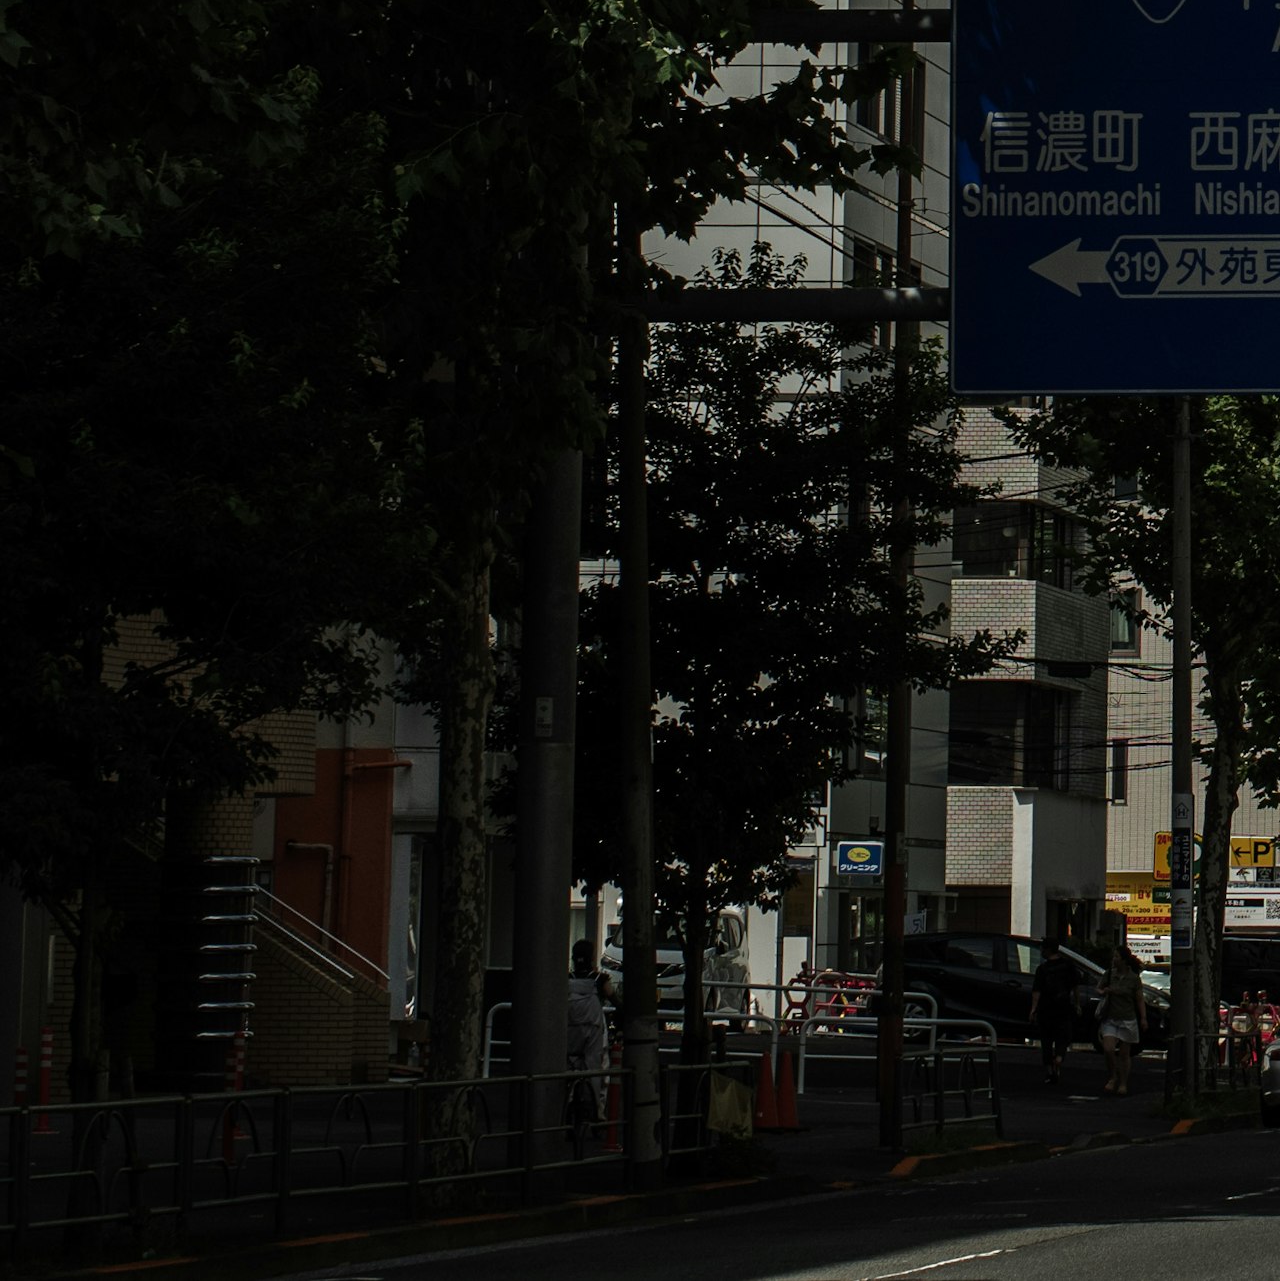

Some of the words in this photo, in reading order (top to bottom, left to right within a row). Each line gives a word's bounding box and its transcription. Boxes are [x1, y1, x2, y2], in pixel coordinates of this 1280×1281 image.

[980, 109, 1143, 173] 信濃町
[962, 184, 1161, 218] Shinanomachi
[1112, 251, 1160, 283] 319
[840, 863, 878, 872] クリーニング
[1253, 841, 1271, 863] P
